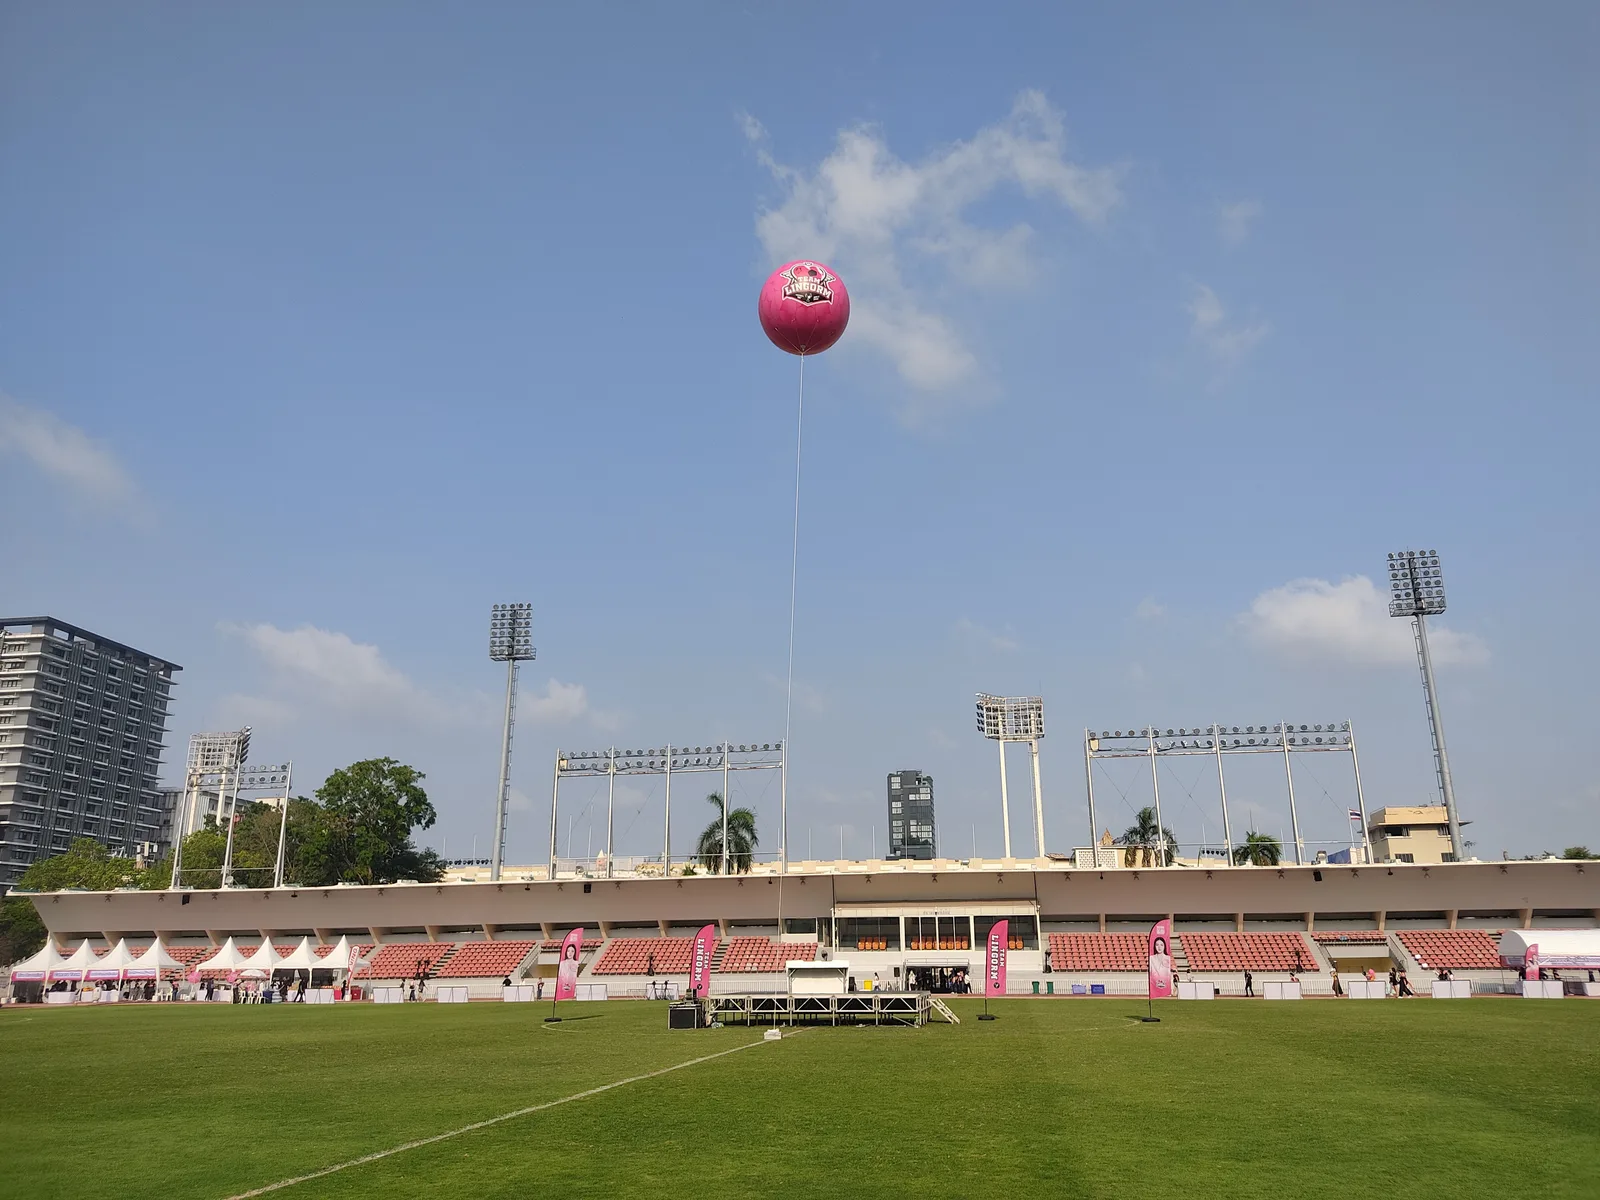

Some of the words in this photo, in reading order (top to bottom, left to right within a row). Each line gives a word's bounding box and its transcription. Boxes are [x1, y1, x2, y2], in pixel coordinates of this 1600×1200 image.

[785, 282, 832, 299] LINGORM
[798, 276, 820, 284] TEAM
[695, 938, 705, 981] LINGORM
[991, 934, 999, 980] LINGORM
